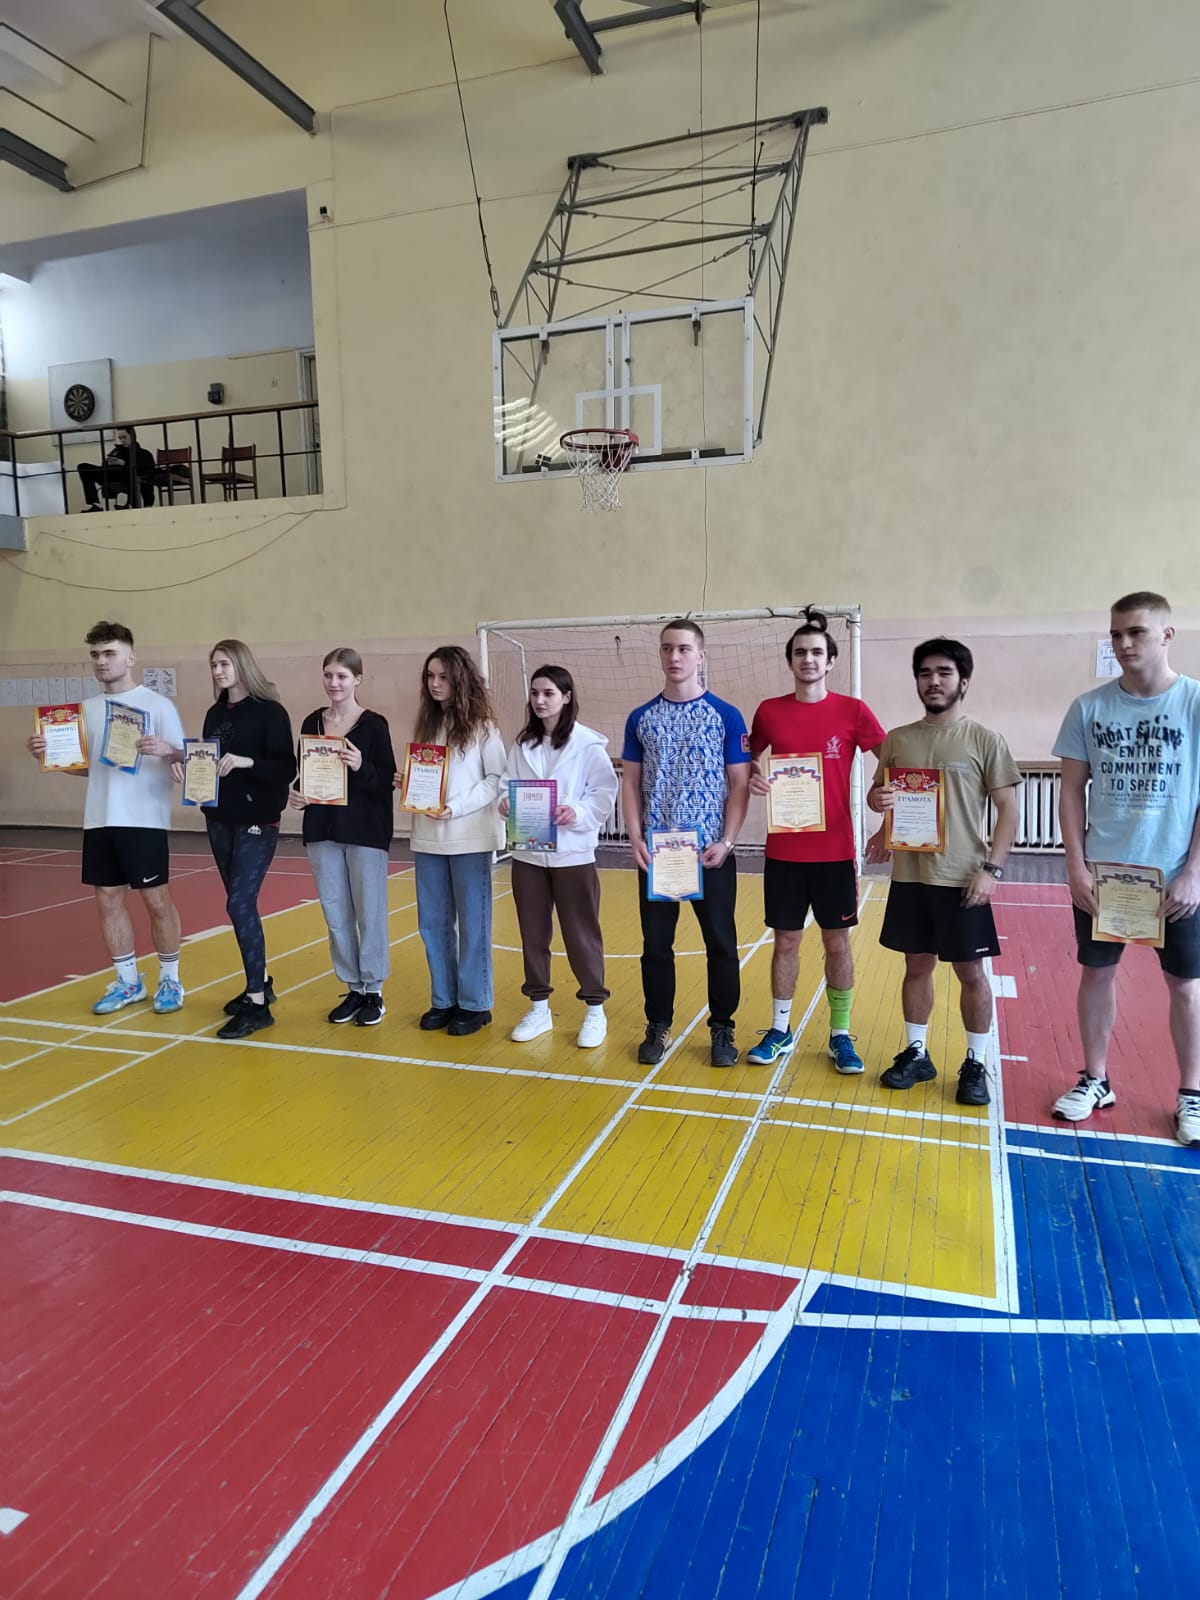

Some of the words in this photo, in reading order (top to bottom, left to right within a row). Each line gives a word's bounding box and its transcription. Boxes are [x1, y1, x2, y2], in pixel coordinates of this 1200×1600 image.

[1119, 745, 1162, 758] ENTIRE
[1101, 761, 1182, 776] COMMITMENT
[1110, 779, 1124, 791] TO
[1130, 779, 1166, 792] SPEED
